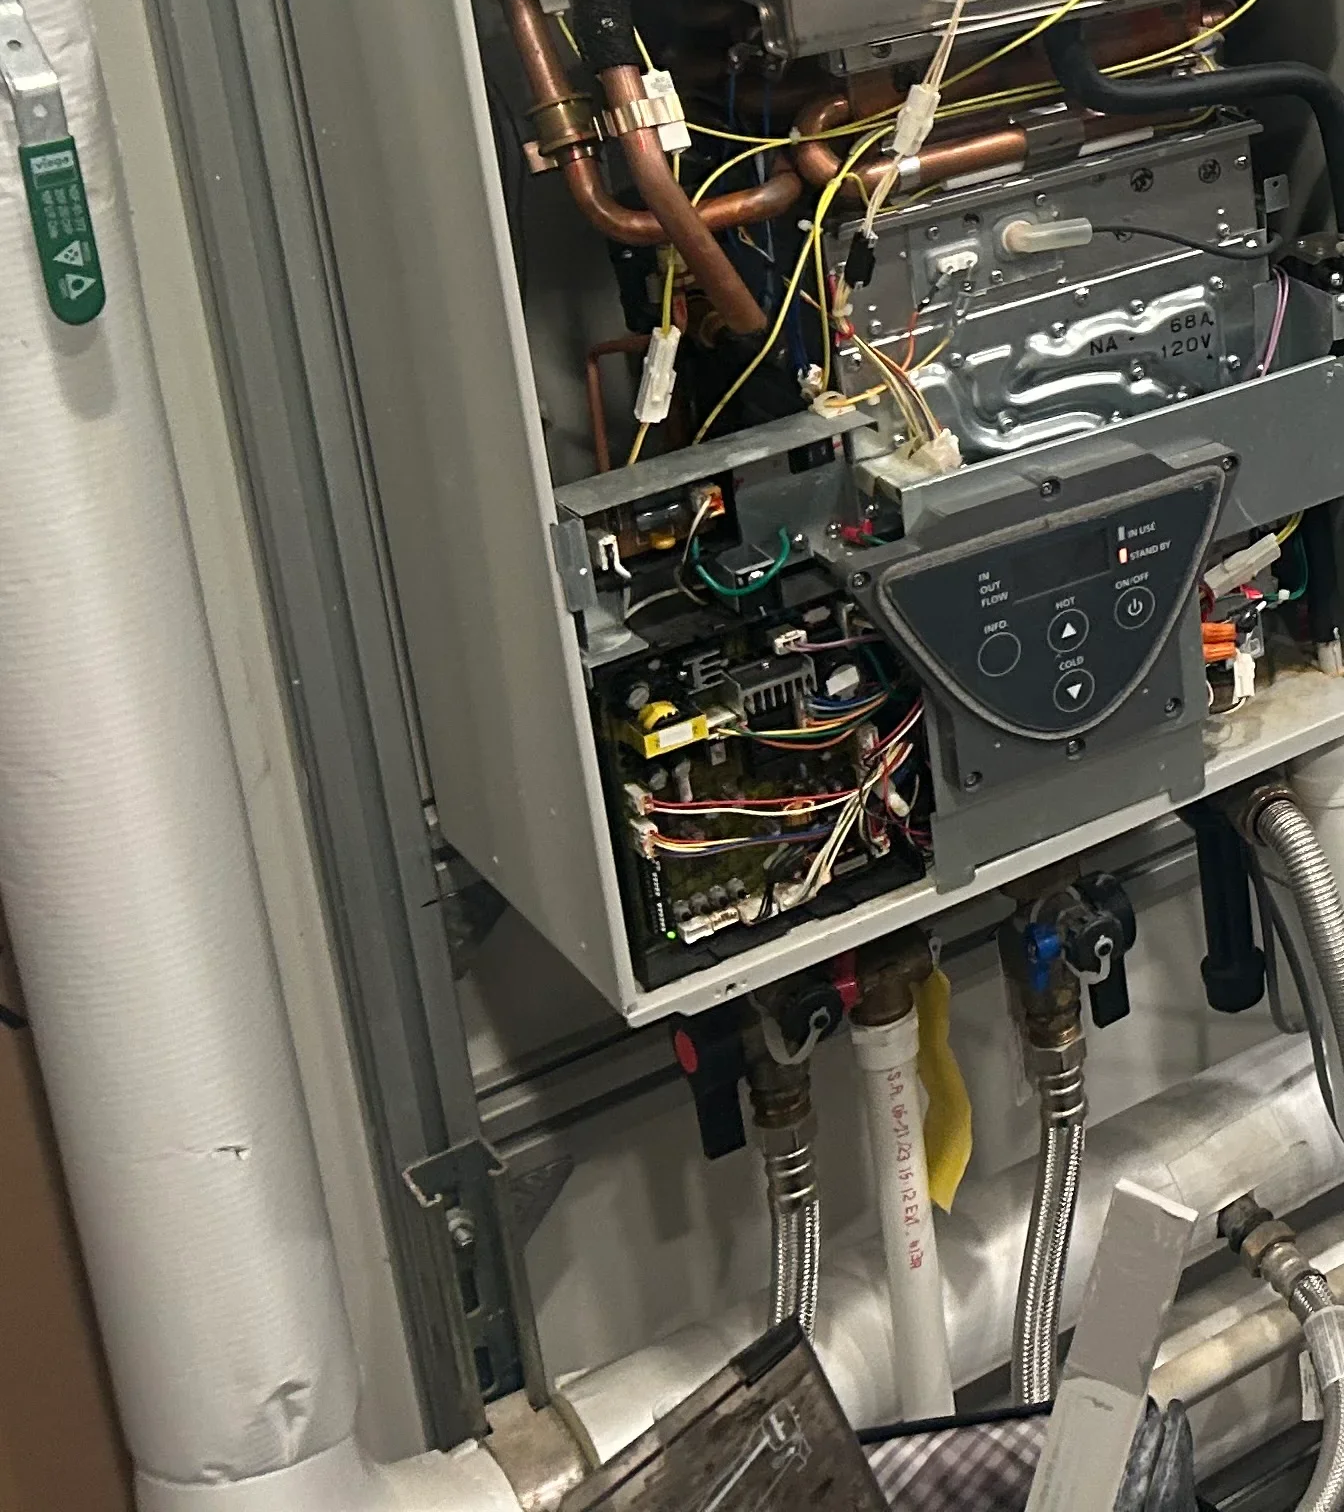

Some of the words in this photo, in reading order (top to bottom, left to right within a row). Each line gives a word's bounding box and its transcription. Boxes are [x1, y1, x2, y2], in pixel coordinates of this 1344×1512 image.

[1090, 335, 1118, 356] NA
[1162, 333, 1211, 359] 120V
[1128, 529, 1138, 538] IN
[1139, 521, 1156, 535] USE
[1130, 545, 1159, 560] STAND
[1160, 541, 1171, 551] BY
[978, 572, 990, 582] IN
[1115, 572, 1149, 589] ON/OFF
[979, 581, 1001, 595] OUT
[981, 592, 1009, 608] FLOW
[1055, 596, 1076, 610] HOT
[1059, 656, 1084, 671] COLD
